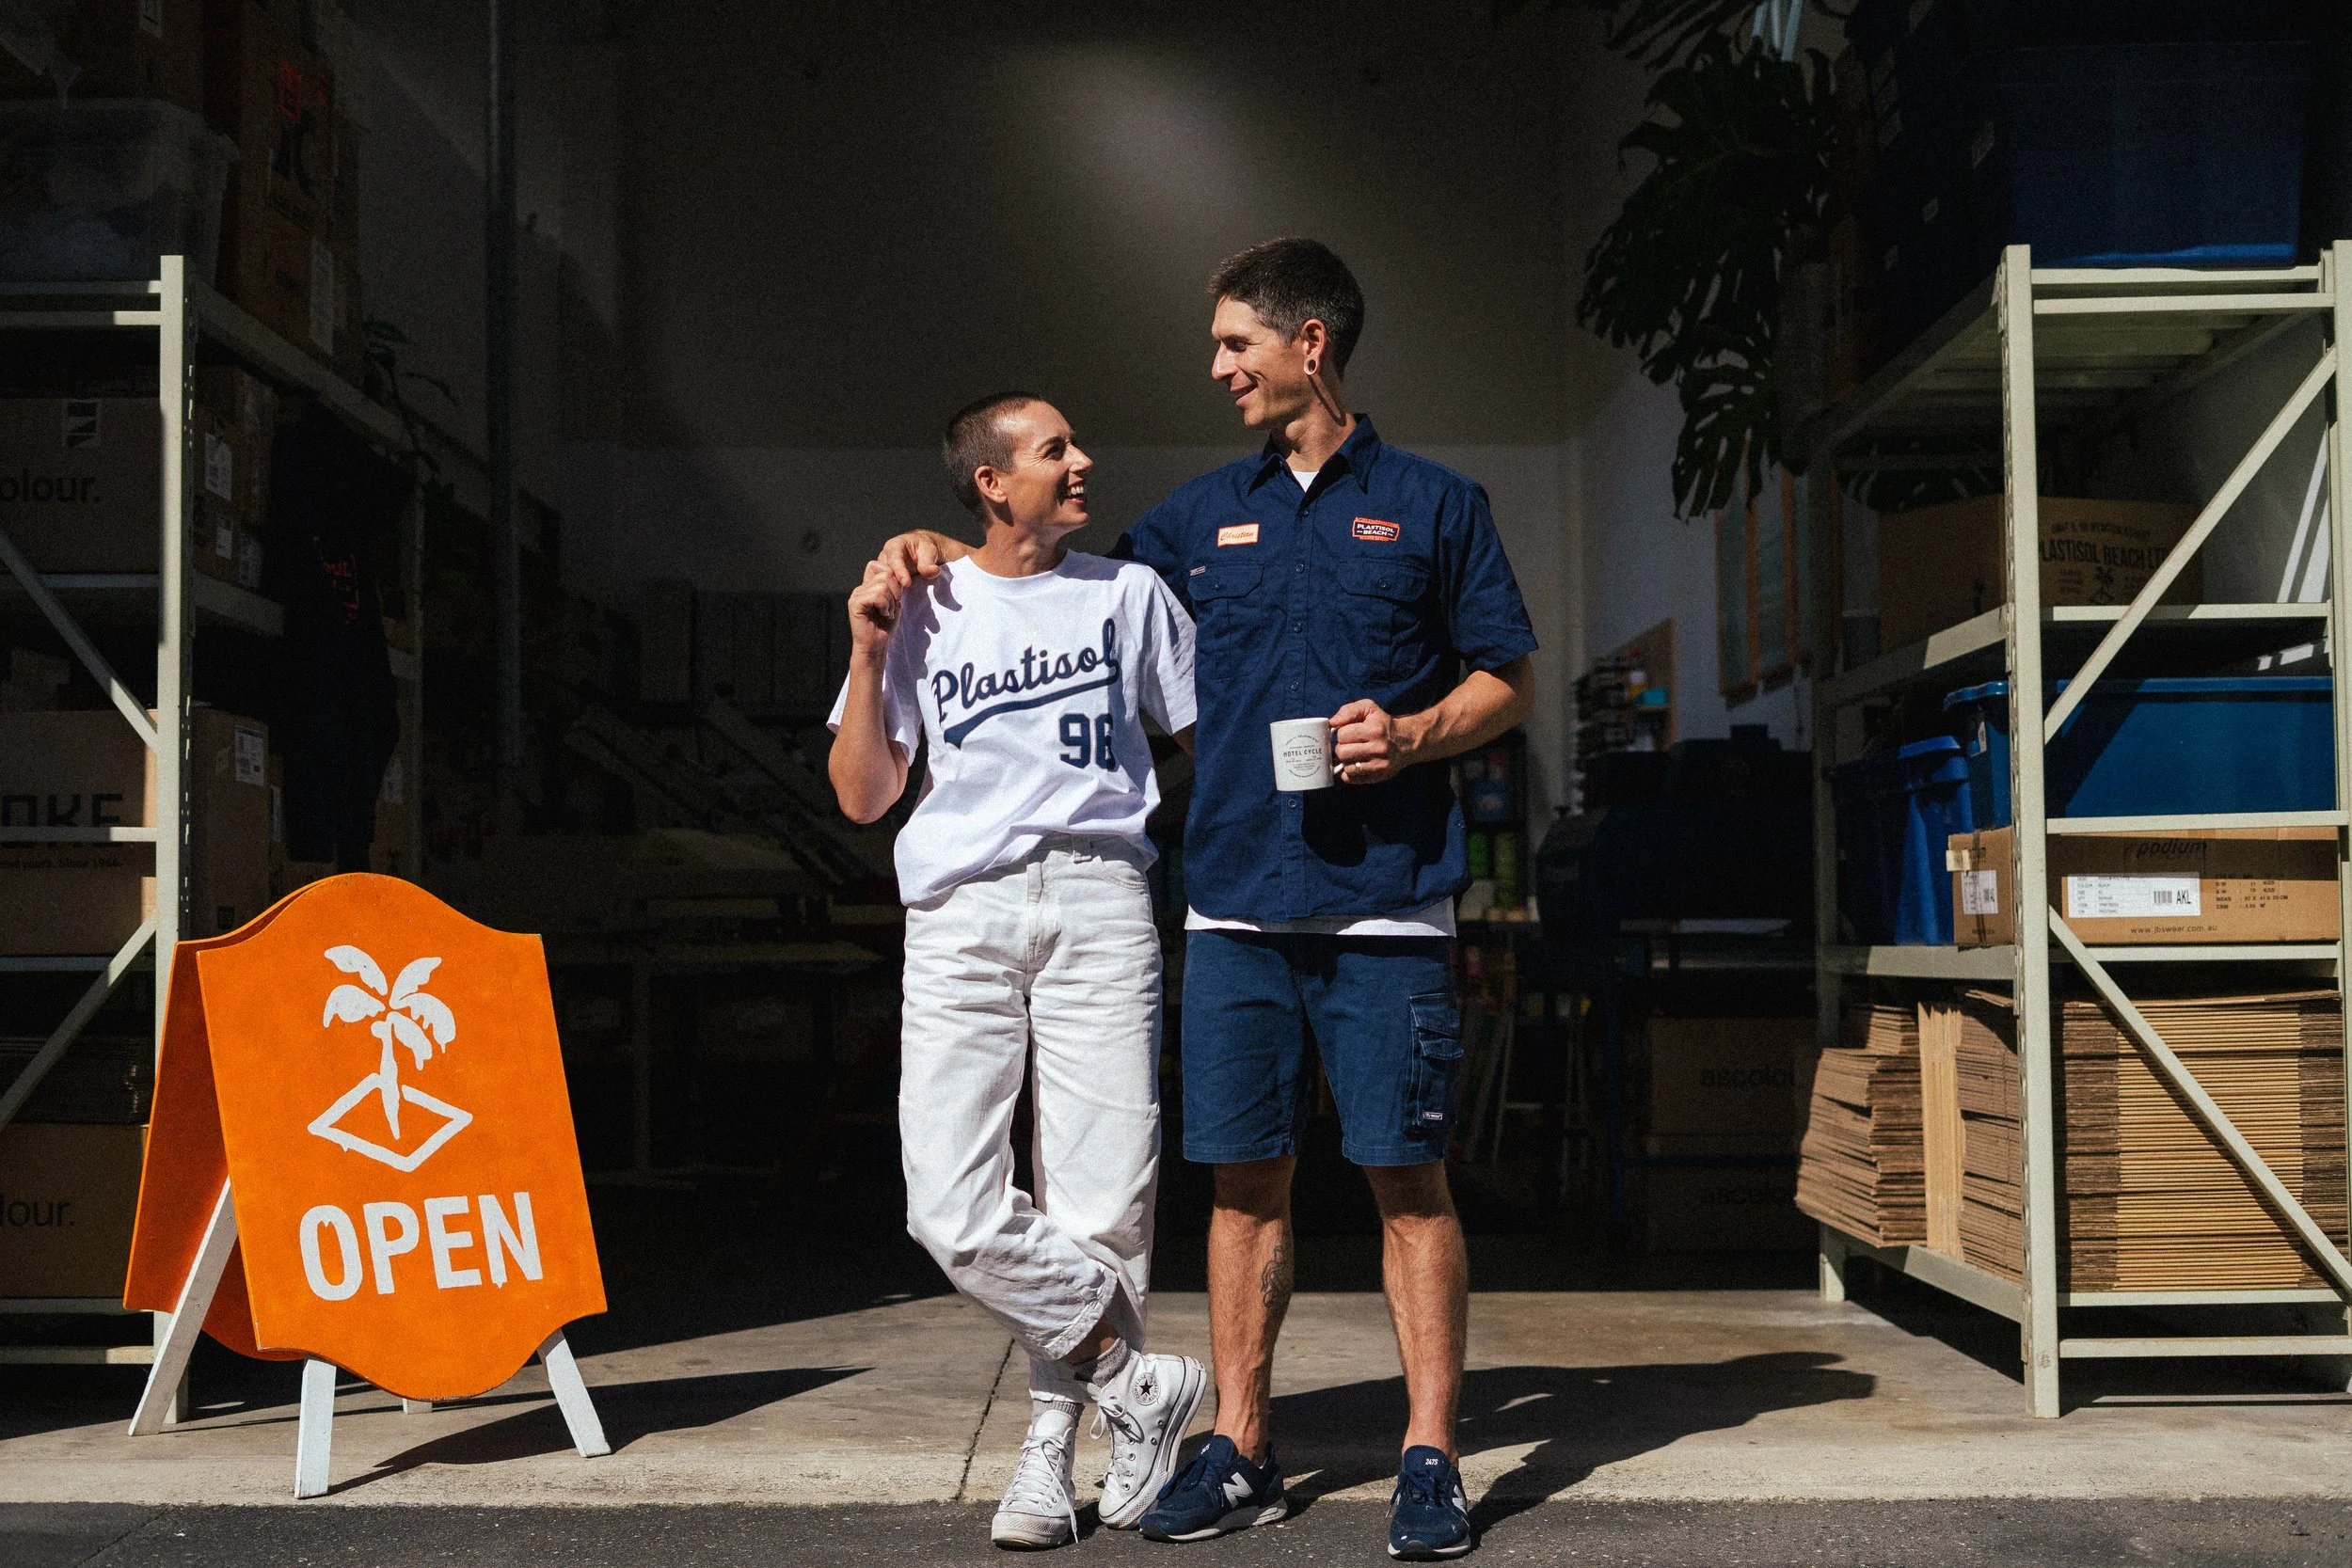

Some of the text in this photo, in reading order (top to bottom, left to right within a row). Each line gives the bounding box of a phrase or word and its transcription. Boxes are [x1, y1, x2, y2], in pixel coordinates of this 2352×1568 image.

[1357, 523, 1395, 533] PLASTISOL
[2104, 546, 2145, 568] BEACH
[931, 618, 1120, 723] Plastisol
[2137, 840, 2207, 860] podium
[58, 857, 89, 868] Since
[2176, 890, 2192, 905] AKL
[299, 1192, 543, 1301] OPEN
